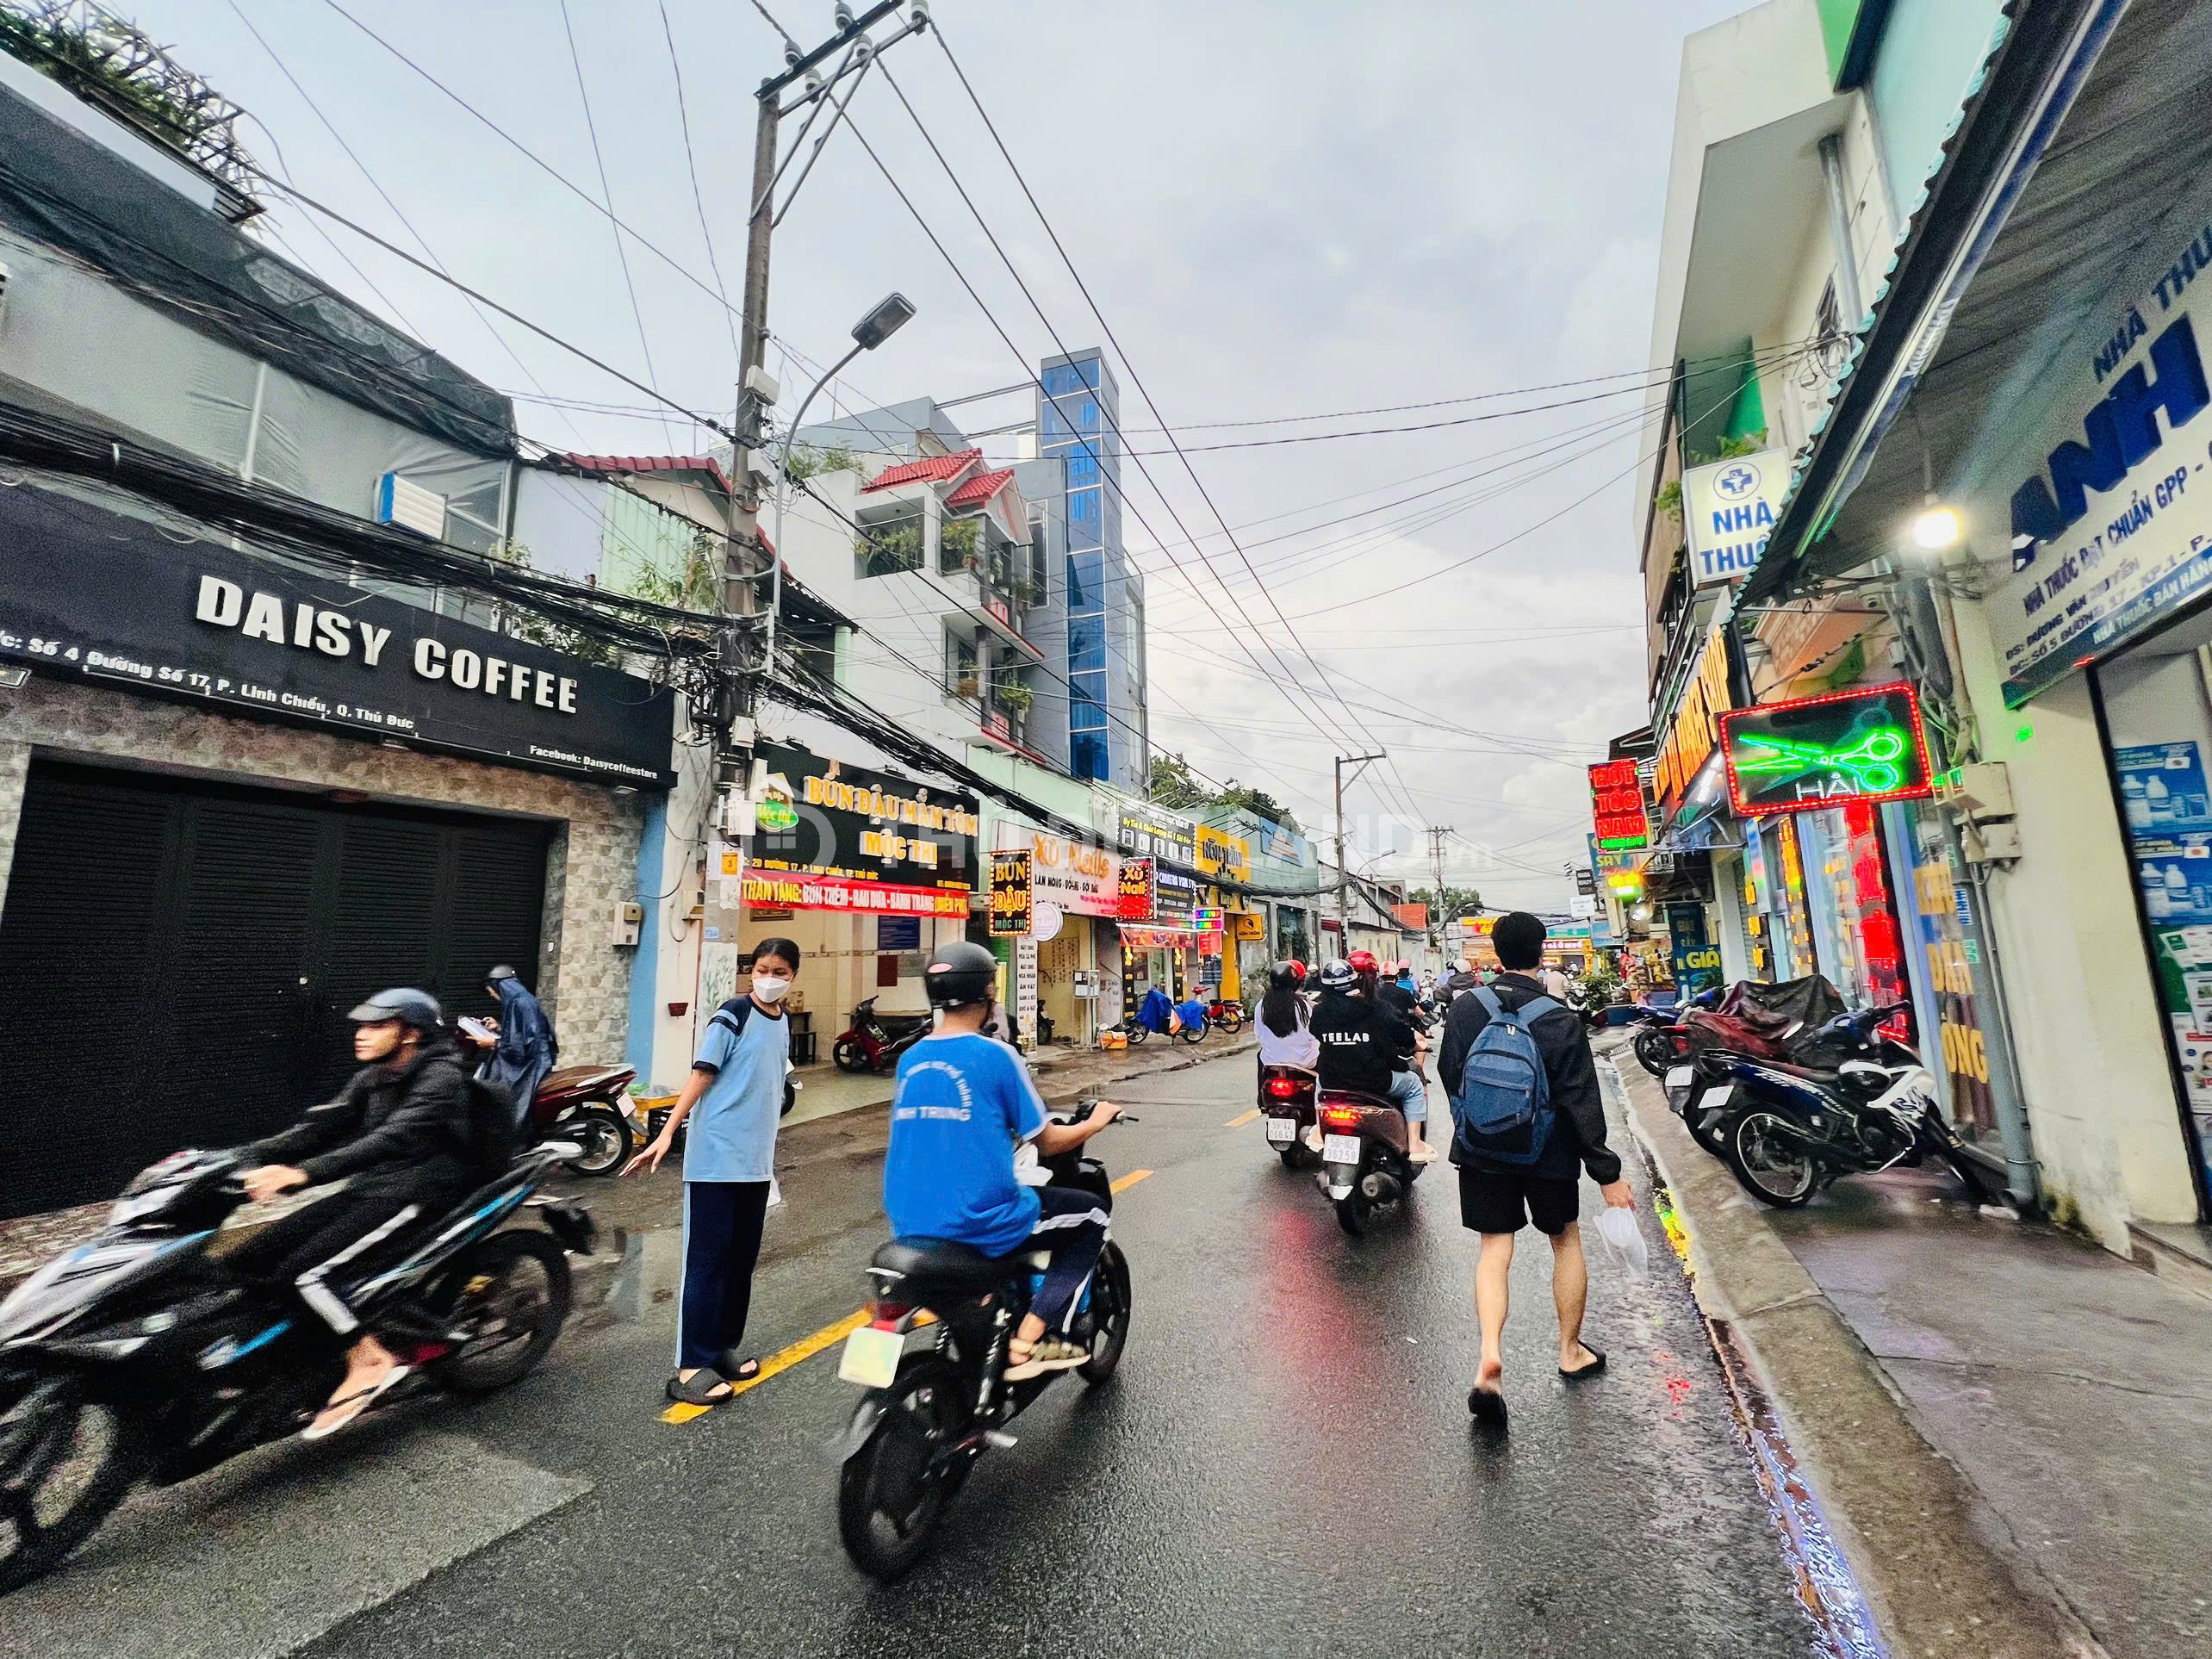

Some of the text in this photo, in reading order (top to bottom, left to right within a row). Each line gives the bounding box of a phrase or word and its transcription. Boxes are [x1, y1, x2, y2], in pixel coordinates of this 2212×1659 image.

[2155, 466, 2188, 509] GPP
[1712, 496, 1773, 534] NHÀ
[28, 637, 61, 656] Số
[65, 647, 80, 662] 4
[158, 665, 187, 682] Số
[196, 575, 578, 714] DAISY COFFEE
[530, 744, 581, 763] Facebook:
[1597, 816, 1646, 838] NAM
[995, 856, 1027, 882] BÚN
[994, 885, 1028, 917] ĐẬU
[1322, 1031, 1370, 1043] TEELAB
